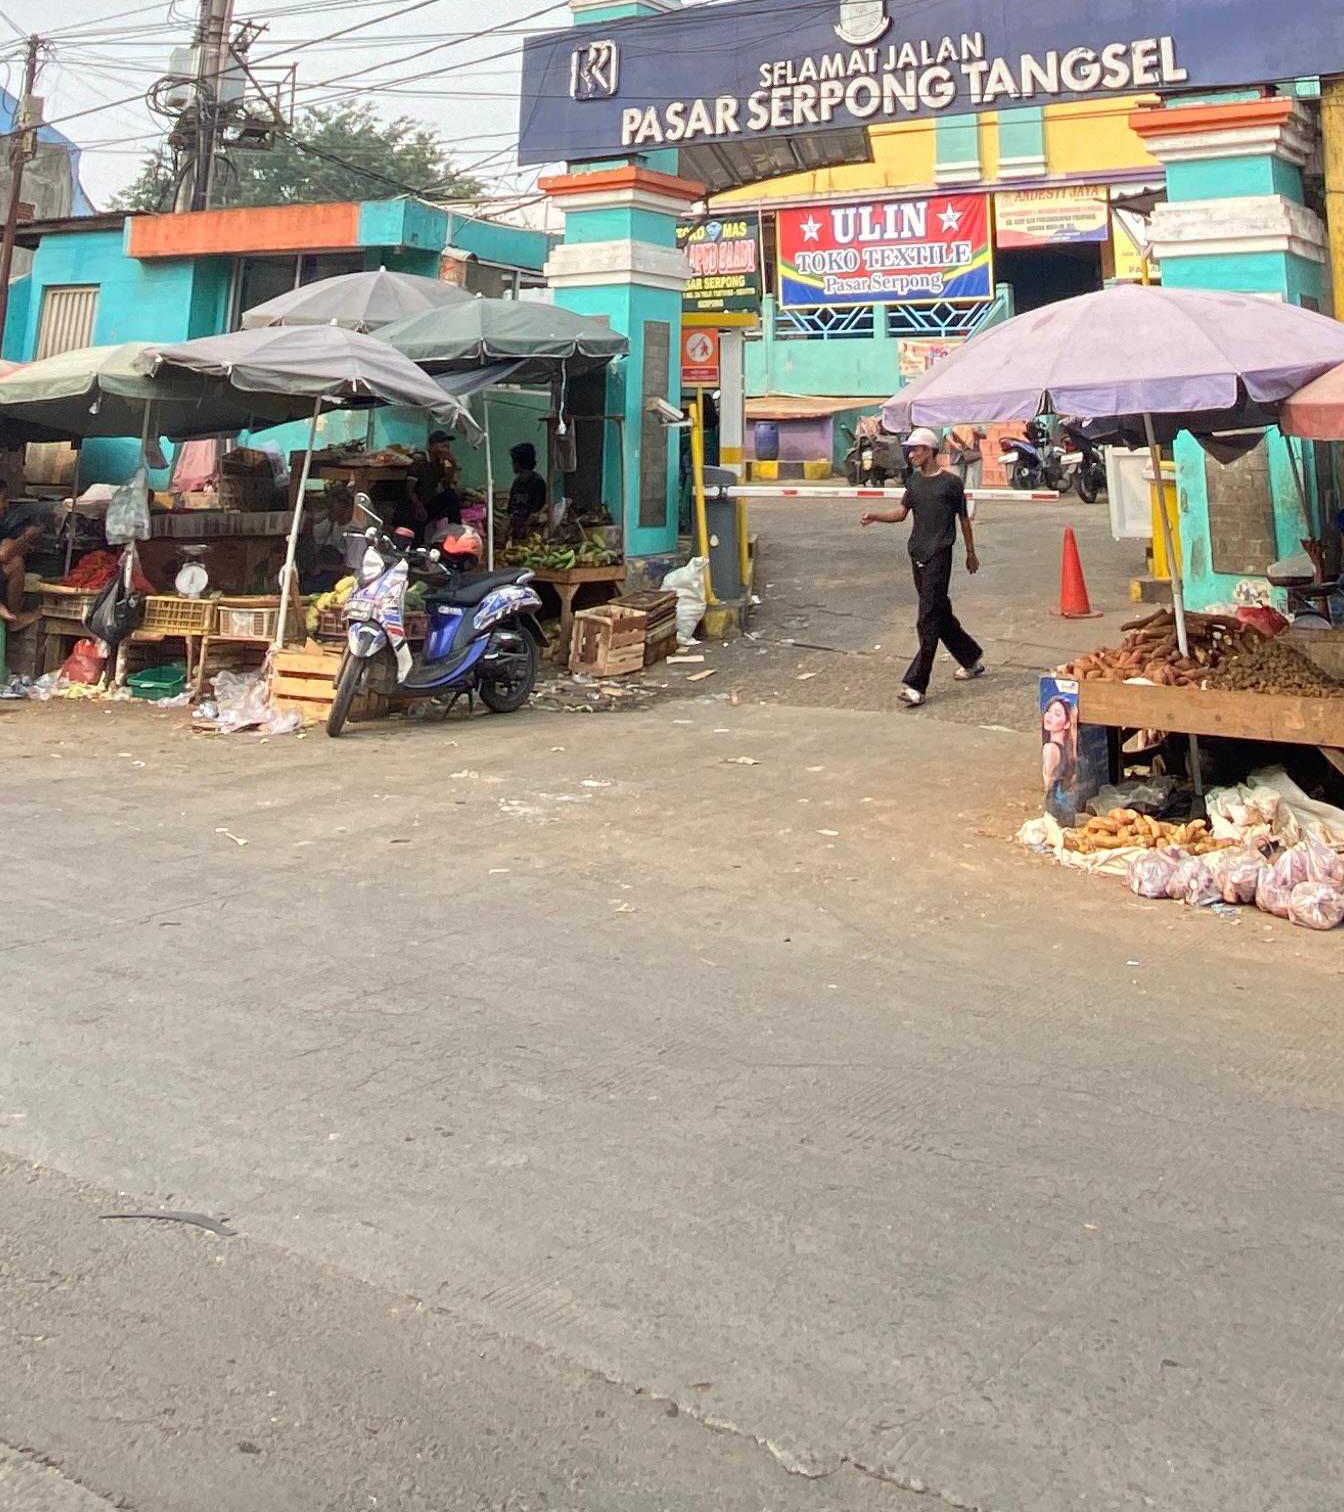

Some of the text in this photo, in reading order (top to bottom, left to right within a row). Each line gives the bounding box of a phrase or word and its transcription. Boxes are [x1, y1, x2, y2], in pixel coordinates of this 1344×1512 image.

[759, 32, 985, 87] SELAMAT JALAN
[622, 35, 1188, 146] PASAR SERPONG TANGSEL
[722, 221, 747, 238] MAS
[831, 201, 928, 244] ULIN
[796, 241, 971, 273] TOKO TEXTILE
[825, 273, 943, 295] Pasar Serpong
